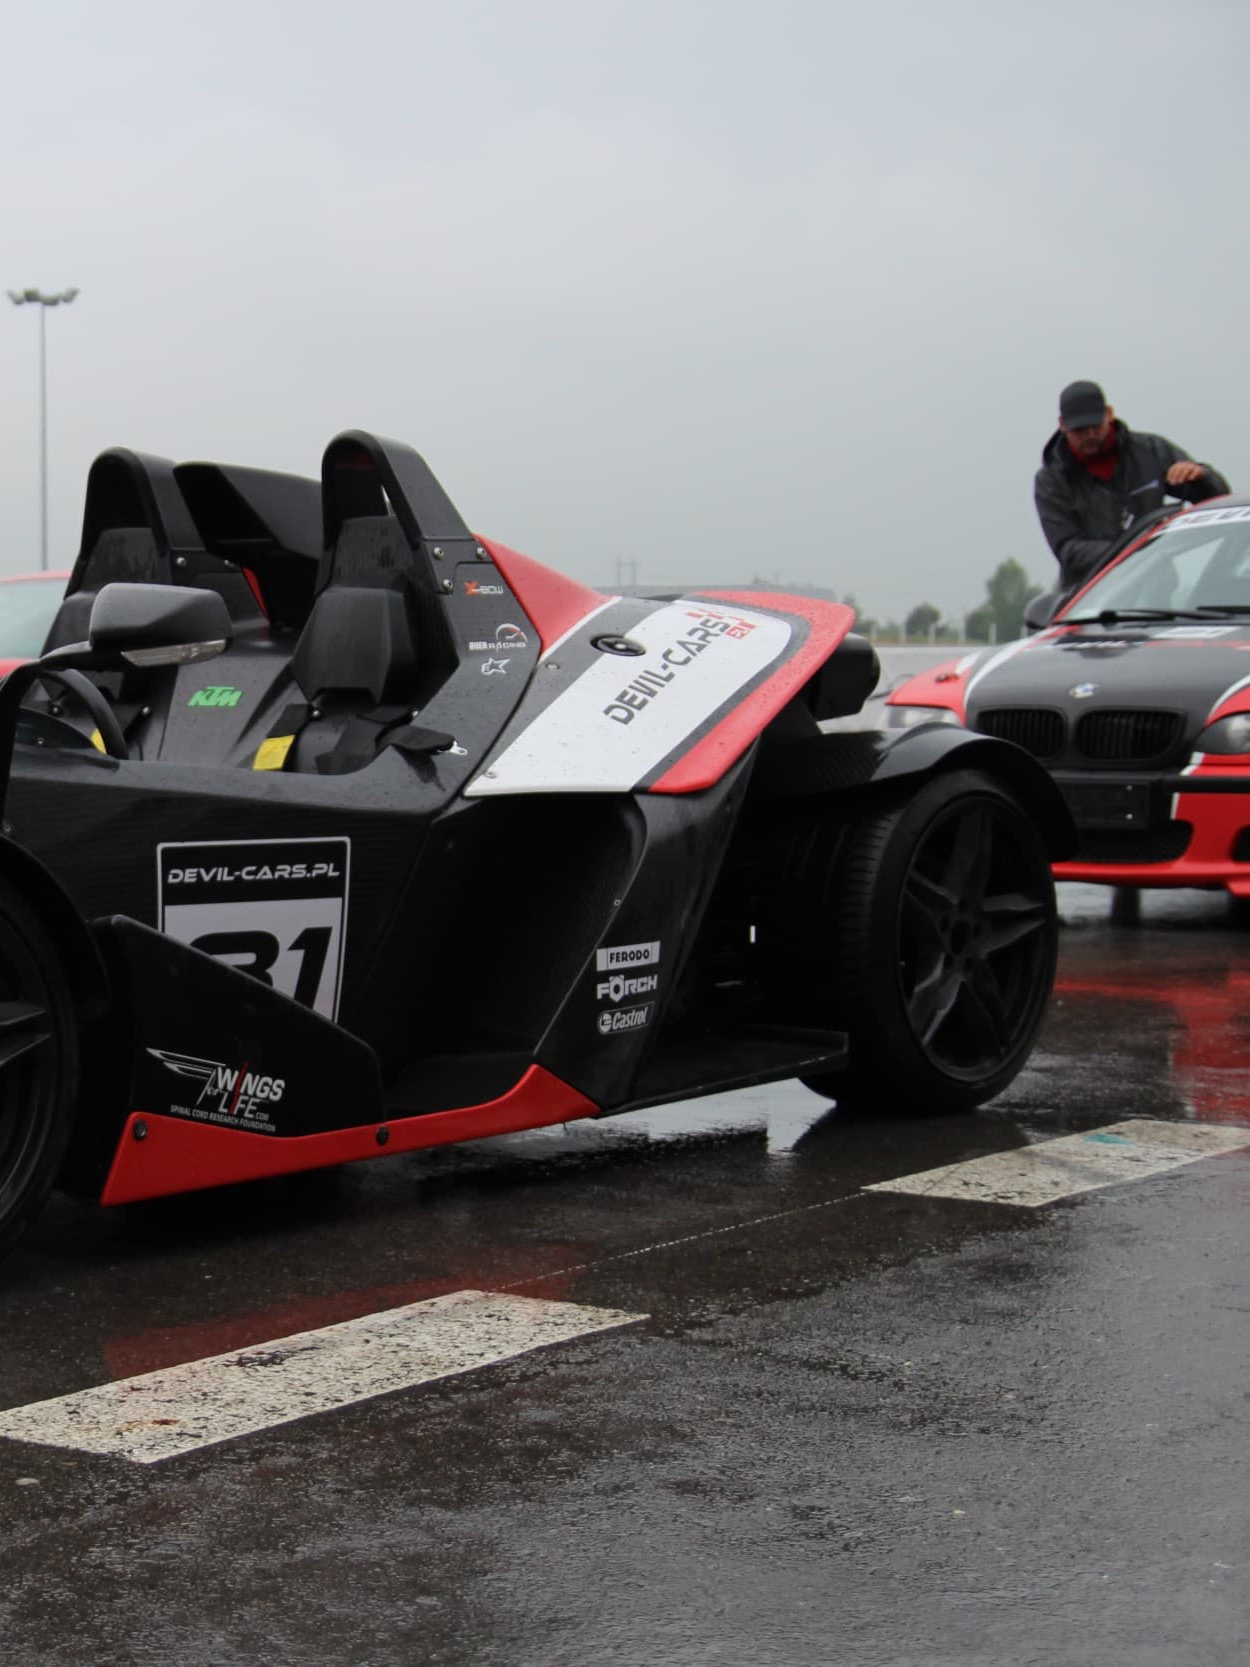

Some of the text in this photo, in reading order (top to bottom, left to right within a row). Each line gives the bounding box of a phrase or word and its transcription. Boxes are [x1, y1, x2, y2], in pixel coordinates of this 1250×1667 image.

[603, 617, 731, 726] DEVIL-CARS
[187, 686, 243, 706] KTM
[167, 862, 341, 884] DEVIL-CARS.PL
[609, 948, 650, 963] FERODO
[612, 1006, 648, 1030] Castrol
[217, 1062, 285, 1101] WINGS
